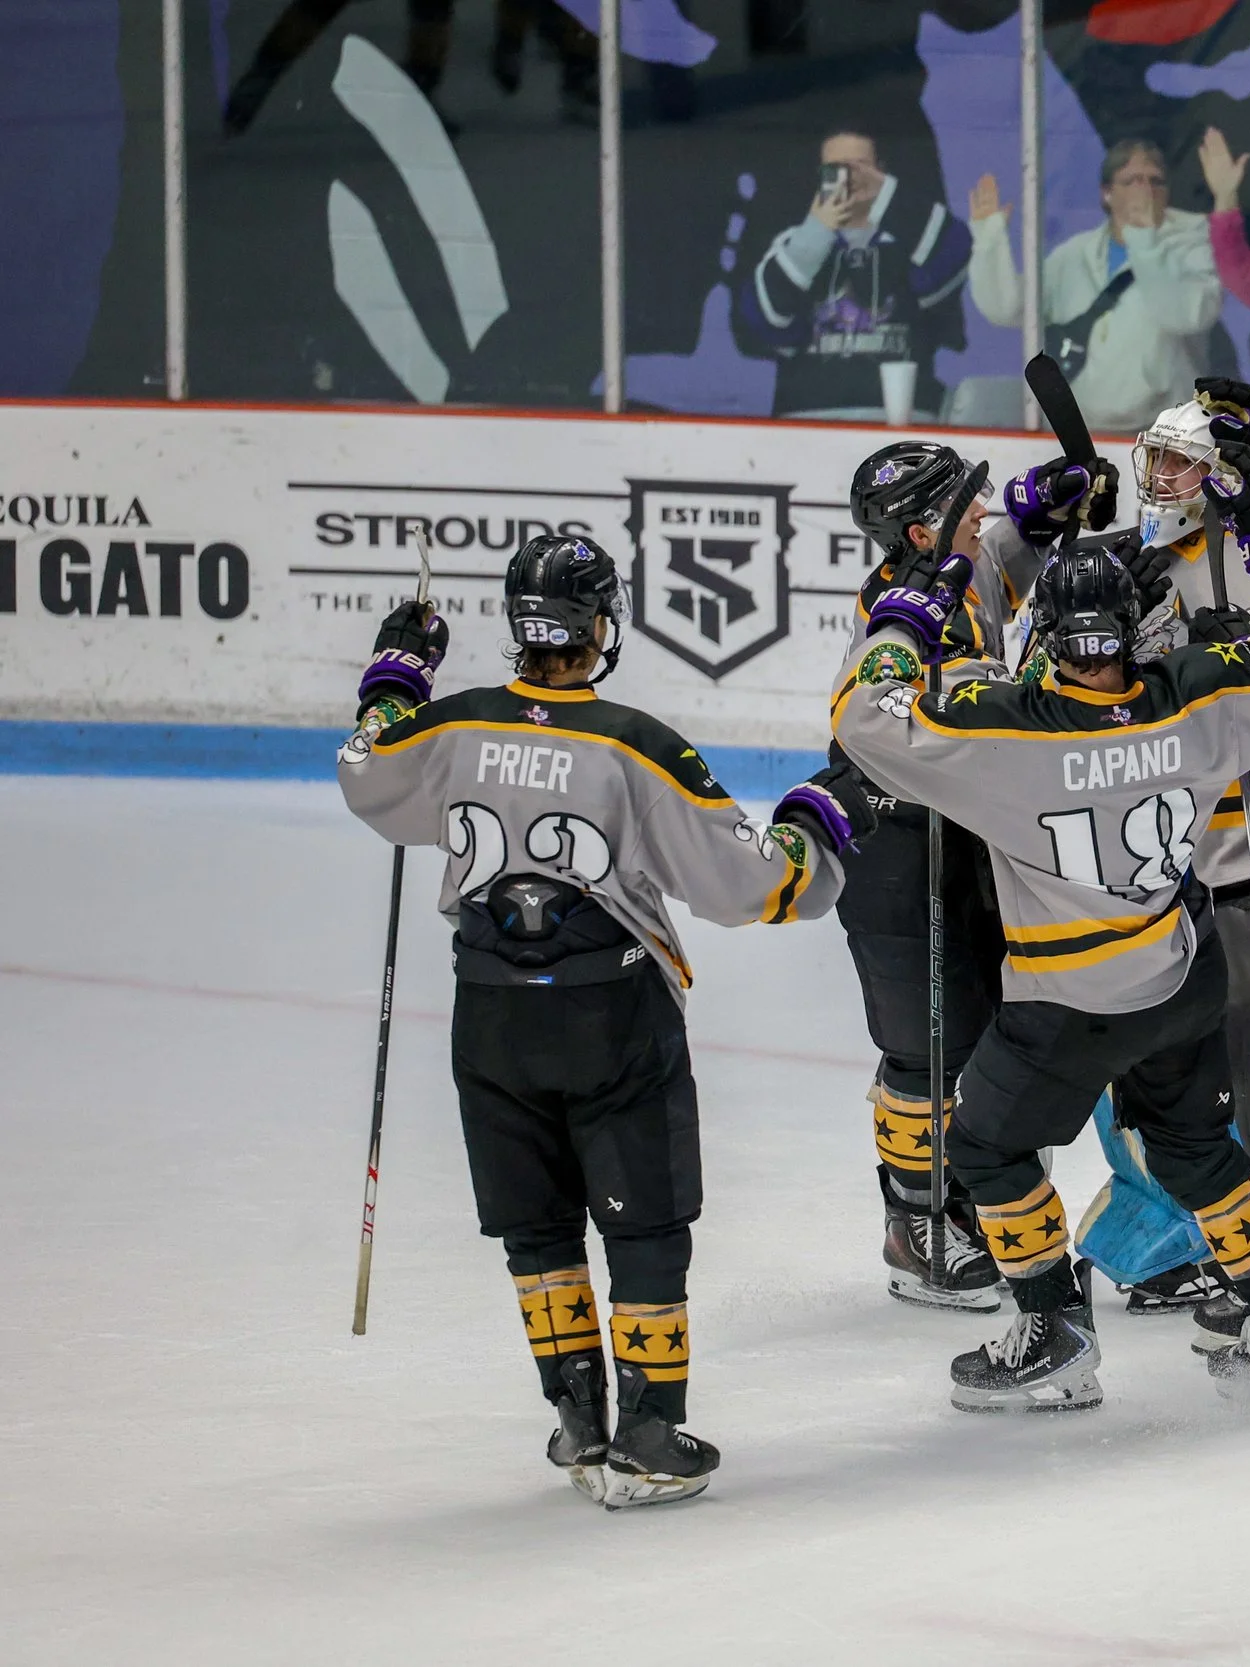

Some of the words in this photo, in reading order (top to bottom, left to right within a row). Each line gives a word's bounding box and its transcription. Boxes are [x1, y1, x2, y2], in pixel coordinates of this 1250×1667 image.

[661, 507, 700, 525] EST
[311, 592, 373, 611] THE
[524, 621, 549, 642] 23
[1077, 636, 1100, 656] 18
[477, 741, 573, 793] PRIER
[1063, 735, 1182, 791] CAPANO
[1038, 787, 1197, 894] 18
[1016, 1355, 1051, 1378] BAUER
